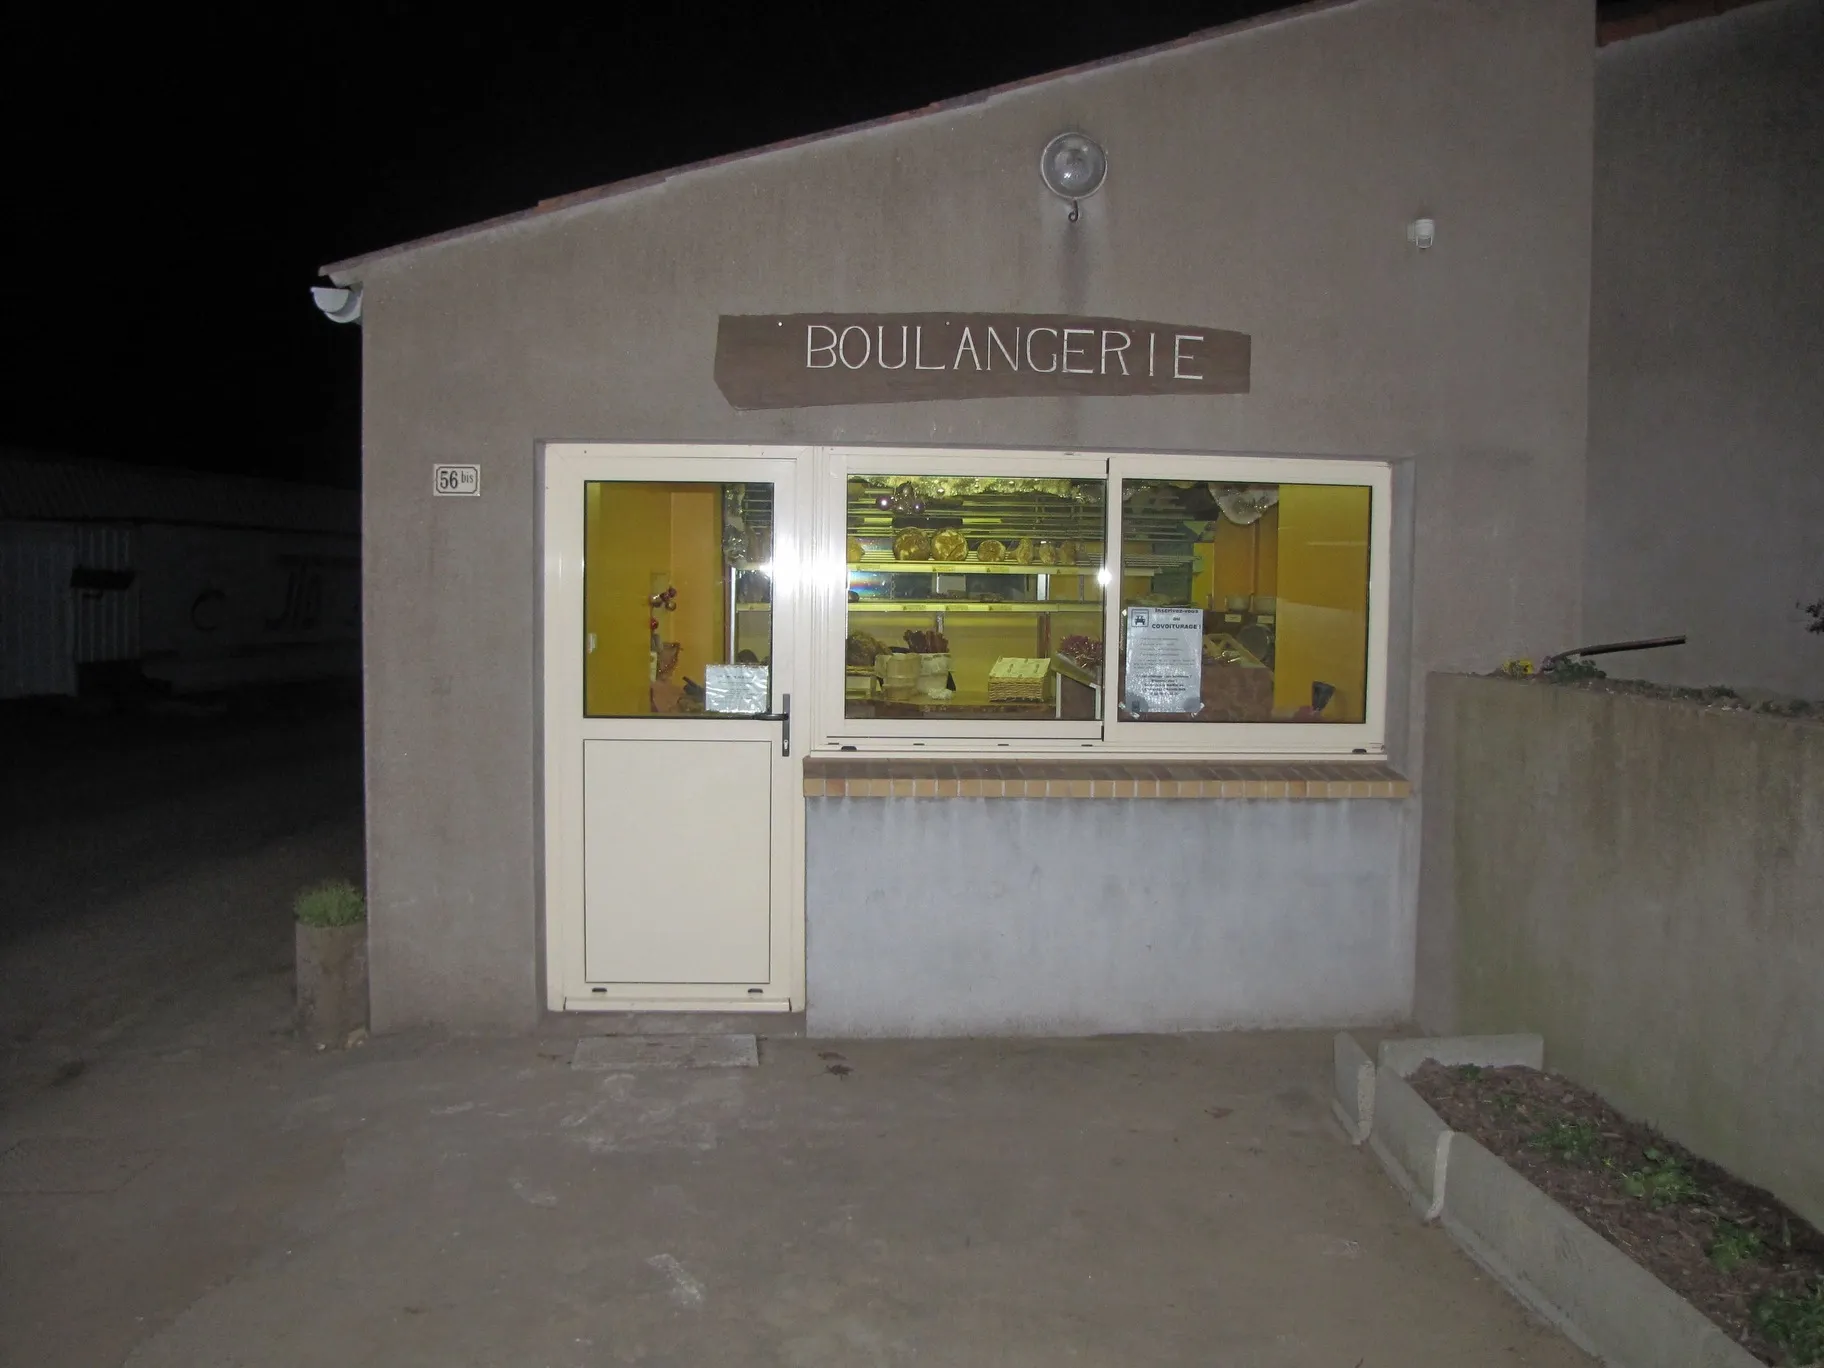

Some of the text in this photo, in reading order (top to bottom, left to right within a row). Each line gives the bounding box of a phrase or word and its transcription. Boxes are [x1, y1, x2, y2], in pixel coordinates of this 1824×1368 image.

[805, 324, 1206, 381] BOULANGERIE
[440, 470, 474, 489] 56 bis
